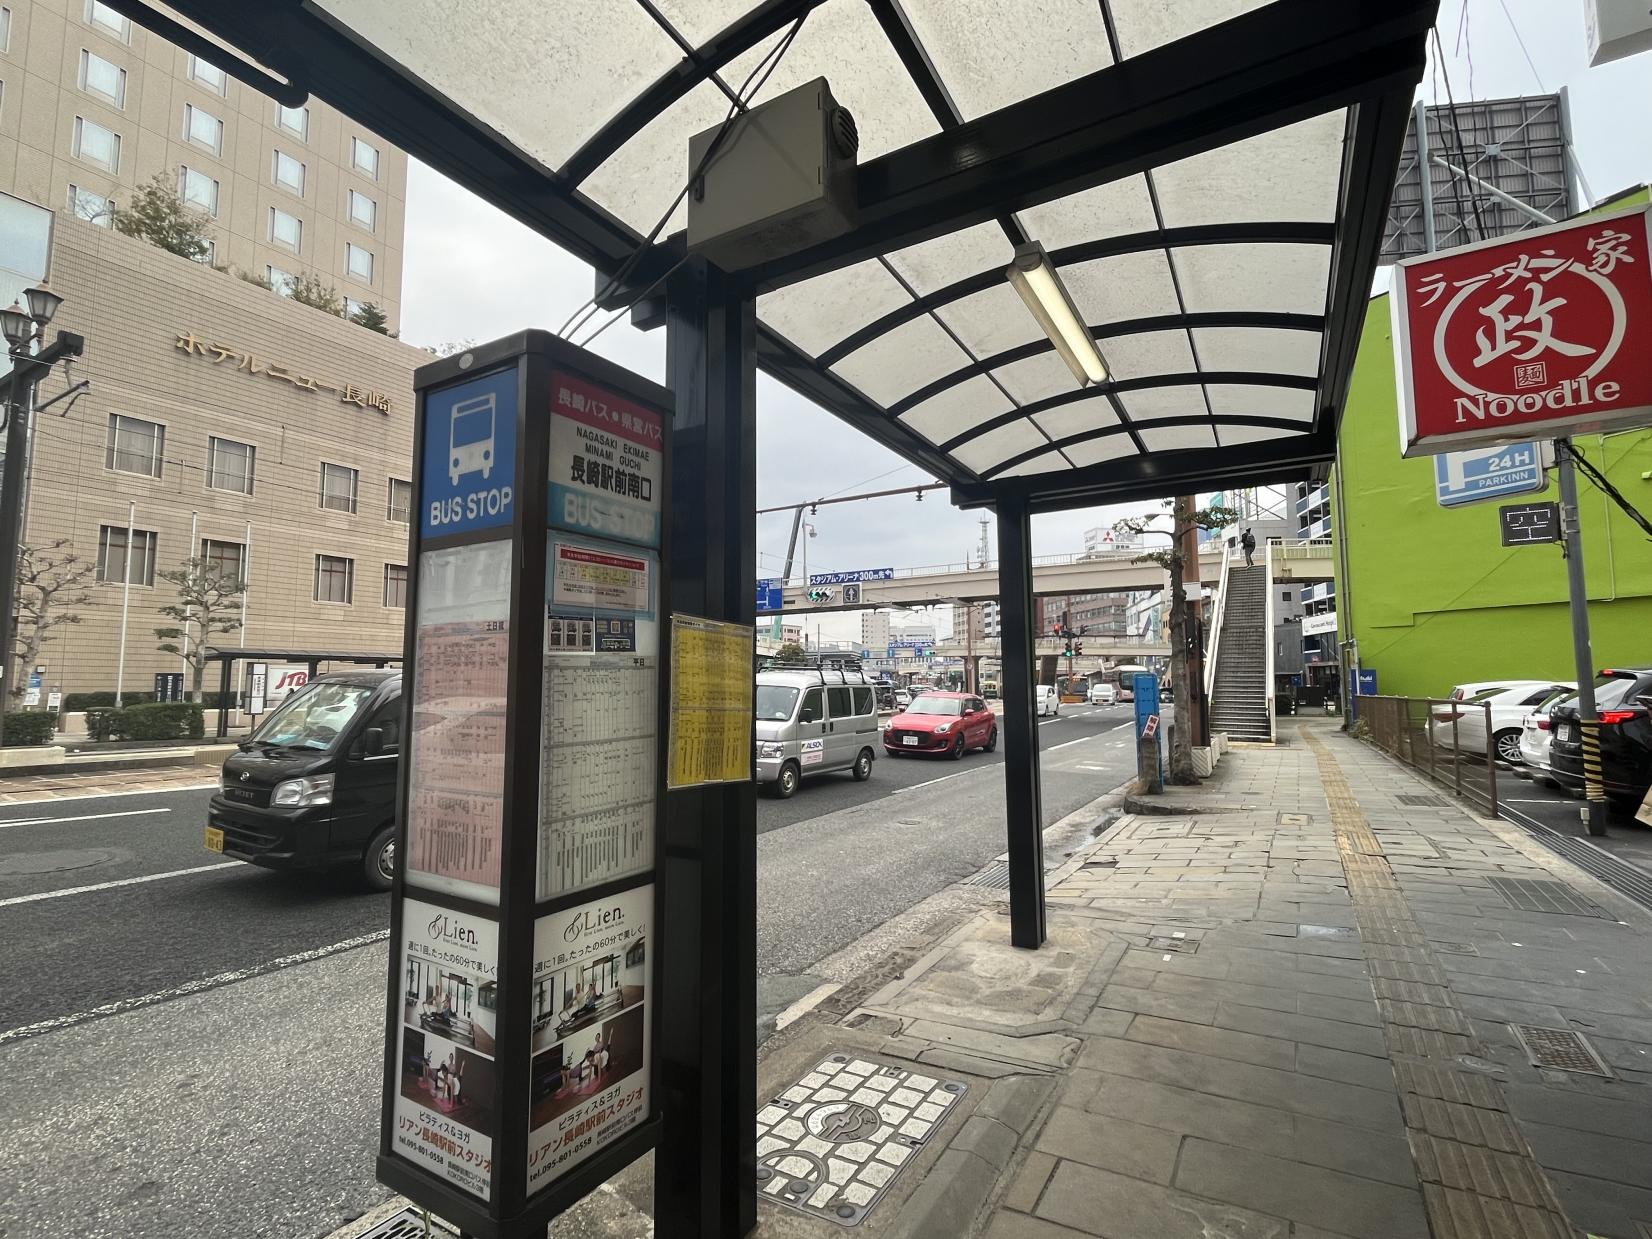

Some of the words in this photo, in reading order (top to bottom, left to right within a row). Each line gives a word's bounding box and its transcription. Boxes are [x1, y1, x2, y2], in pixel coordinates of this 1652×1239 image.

[1472, 282, 1597, 368] 政
[176, 331, 392, 416] ホテルニュー長崎
[1454, 375, 1621, 423] Noodle
[576, 425, 618, 449] NAGASAKI
[623, 443, 650, 462] EKIMAE
[585, 442, 614, 461] MINAMI
[619, 455, 641, 471] GUCHI
[571, 454, 652, 503] 長崎駅前南口
[1480, 471, 1528, 487] PARKINN
[431, 496, 462, 526] BUS
[466, 486, 512, 519] STOP
[564, 491, 600, 530] BUS
[275, 671, 308, 690] JTB
[528, 1087, 644, 1168] リアン長崎駅前スタジオ
